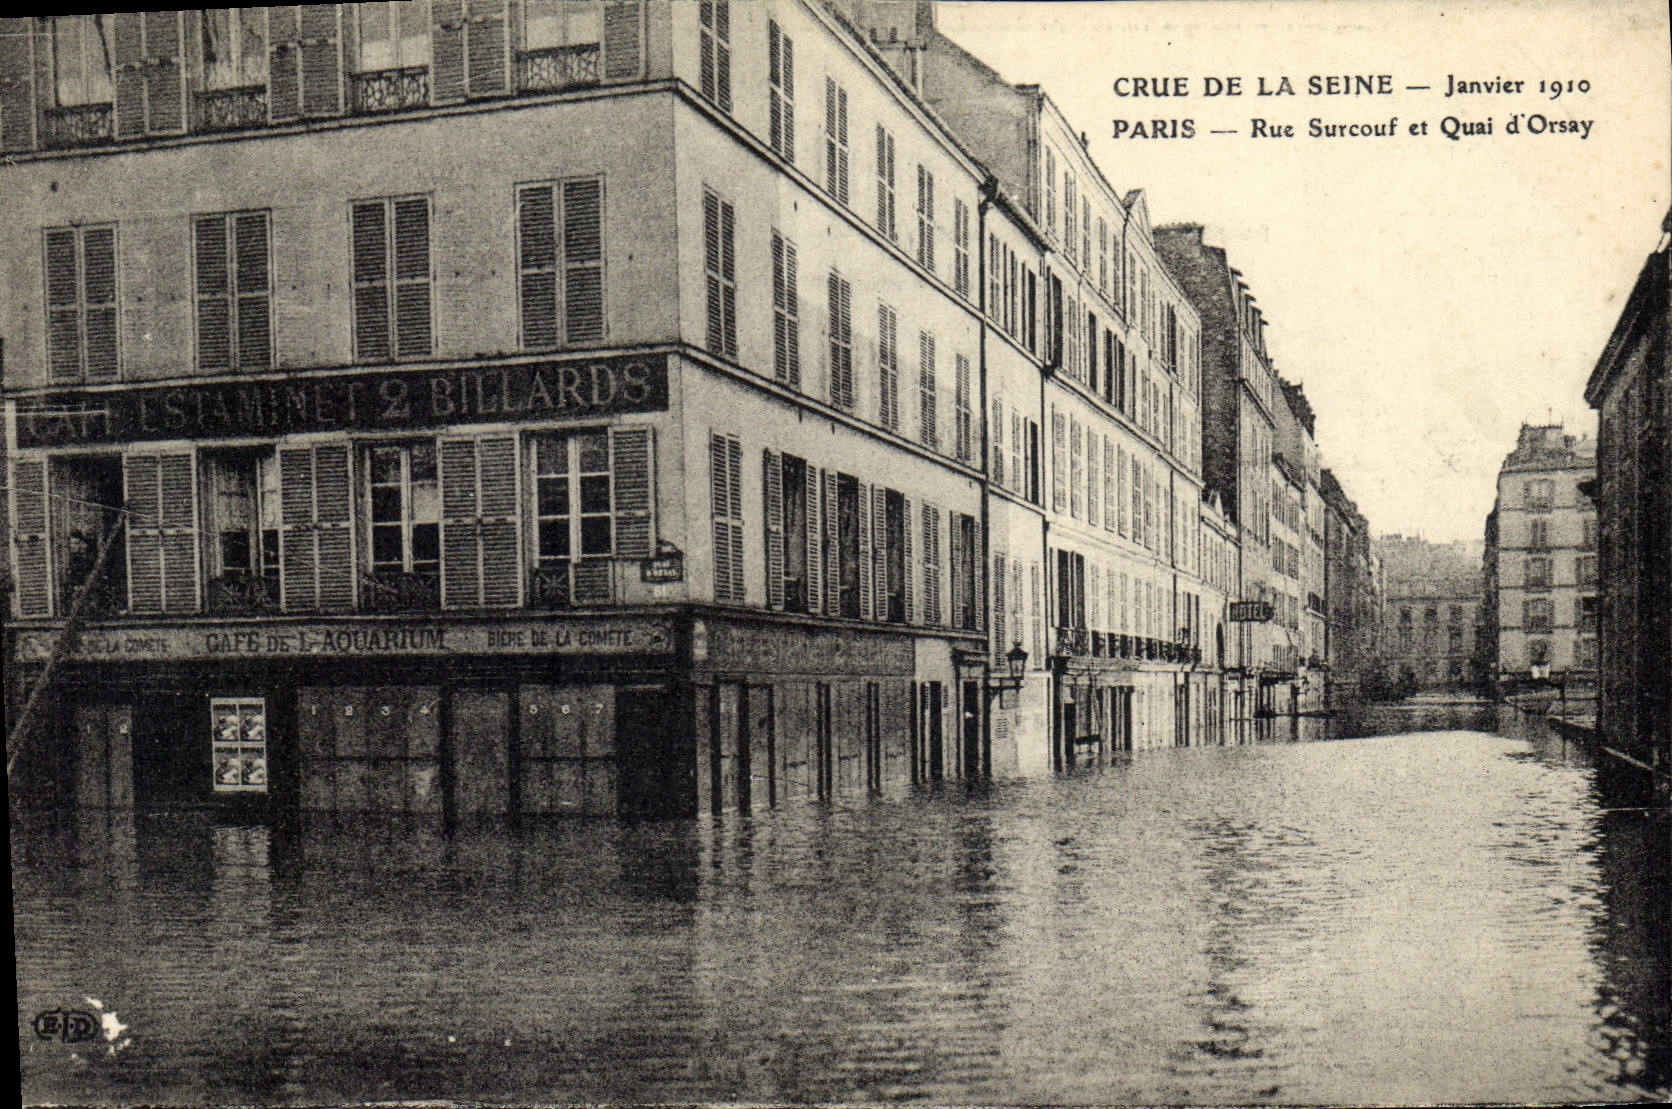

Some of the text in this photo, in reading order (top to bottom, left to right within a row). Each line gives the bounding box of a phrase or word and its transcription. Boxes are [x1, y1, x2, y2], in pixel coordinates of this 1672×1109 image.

[379, 378, 410, 418] 2
[431, 363, 650, 417] BILLARDS
[266, 634, 290, 653] DE
[531, 629, 548, 647] DE
[555, 629, 572, 647] LA
[381, 705, 391, 716] 3
